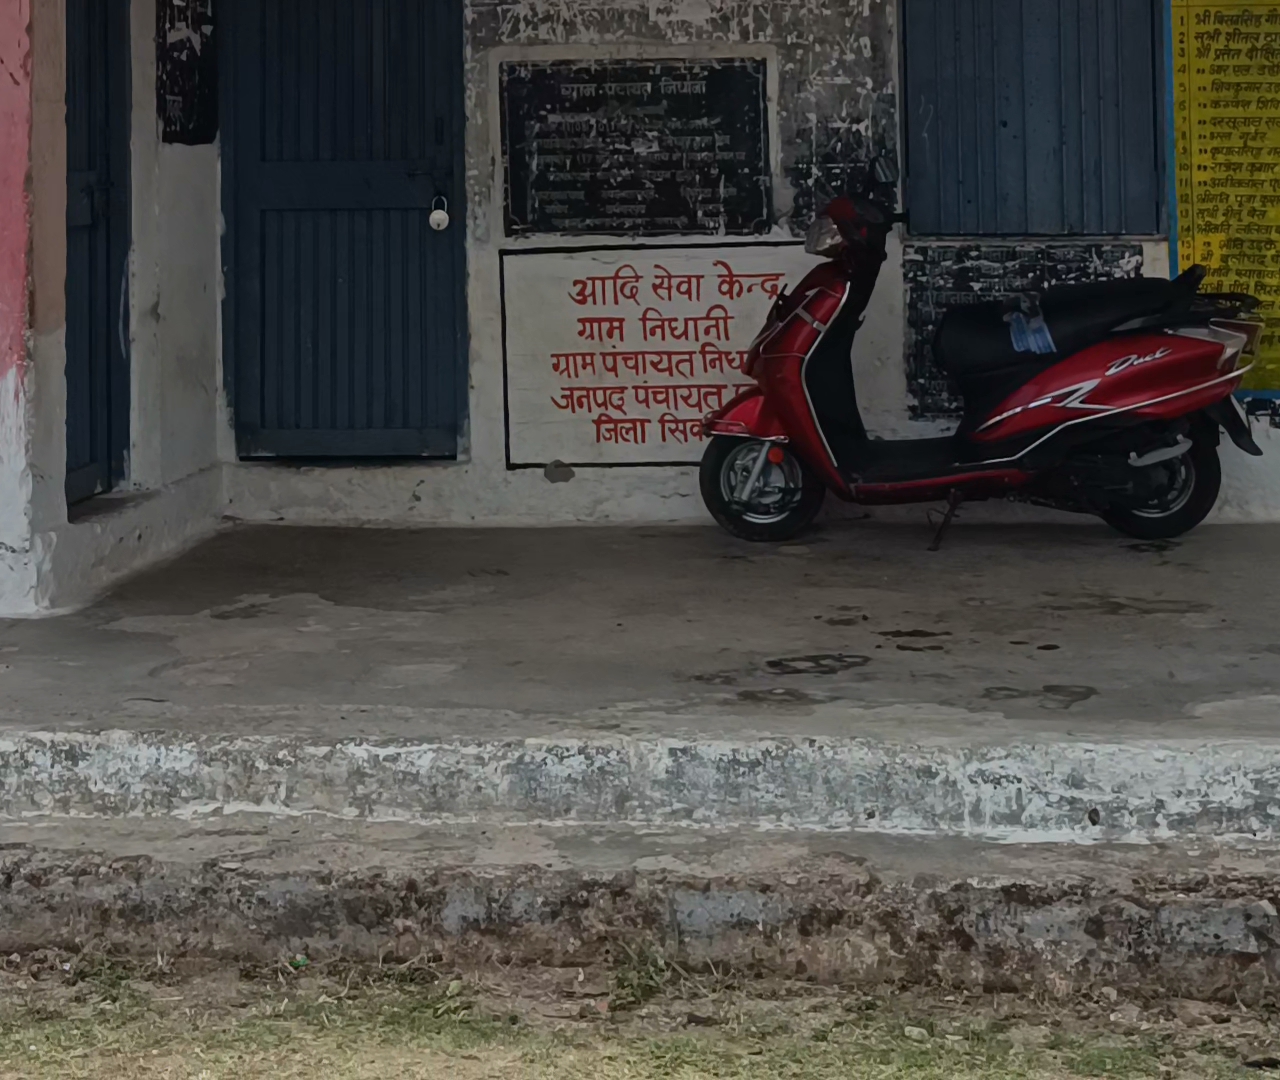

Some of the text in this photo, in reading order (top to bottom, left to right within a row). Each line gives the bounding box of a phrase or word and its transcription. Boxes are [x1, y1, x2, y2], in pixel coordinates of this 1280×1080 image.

[1179, 32, 1185, 44] 2
[1178, 65, 1186, 74] 4
[1179, 100, 1186, 111] 6
[568, 259, 785, 306] आदि सेवा केन्द्र
[577, 304, 734, 342] ग्राम निधानी
[551, 353, 595, 378] ग्राम
[600, 344, 697, 378] पंचायत
[551, 386, 628, 415] जनपद
[632, 380, 727, 413] पंचायत
[592, 413, 705, 444] जिला सिव
